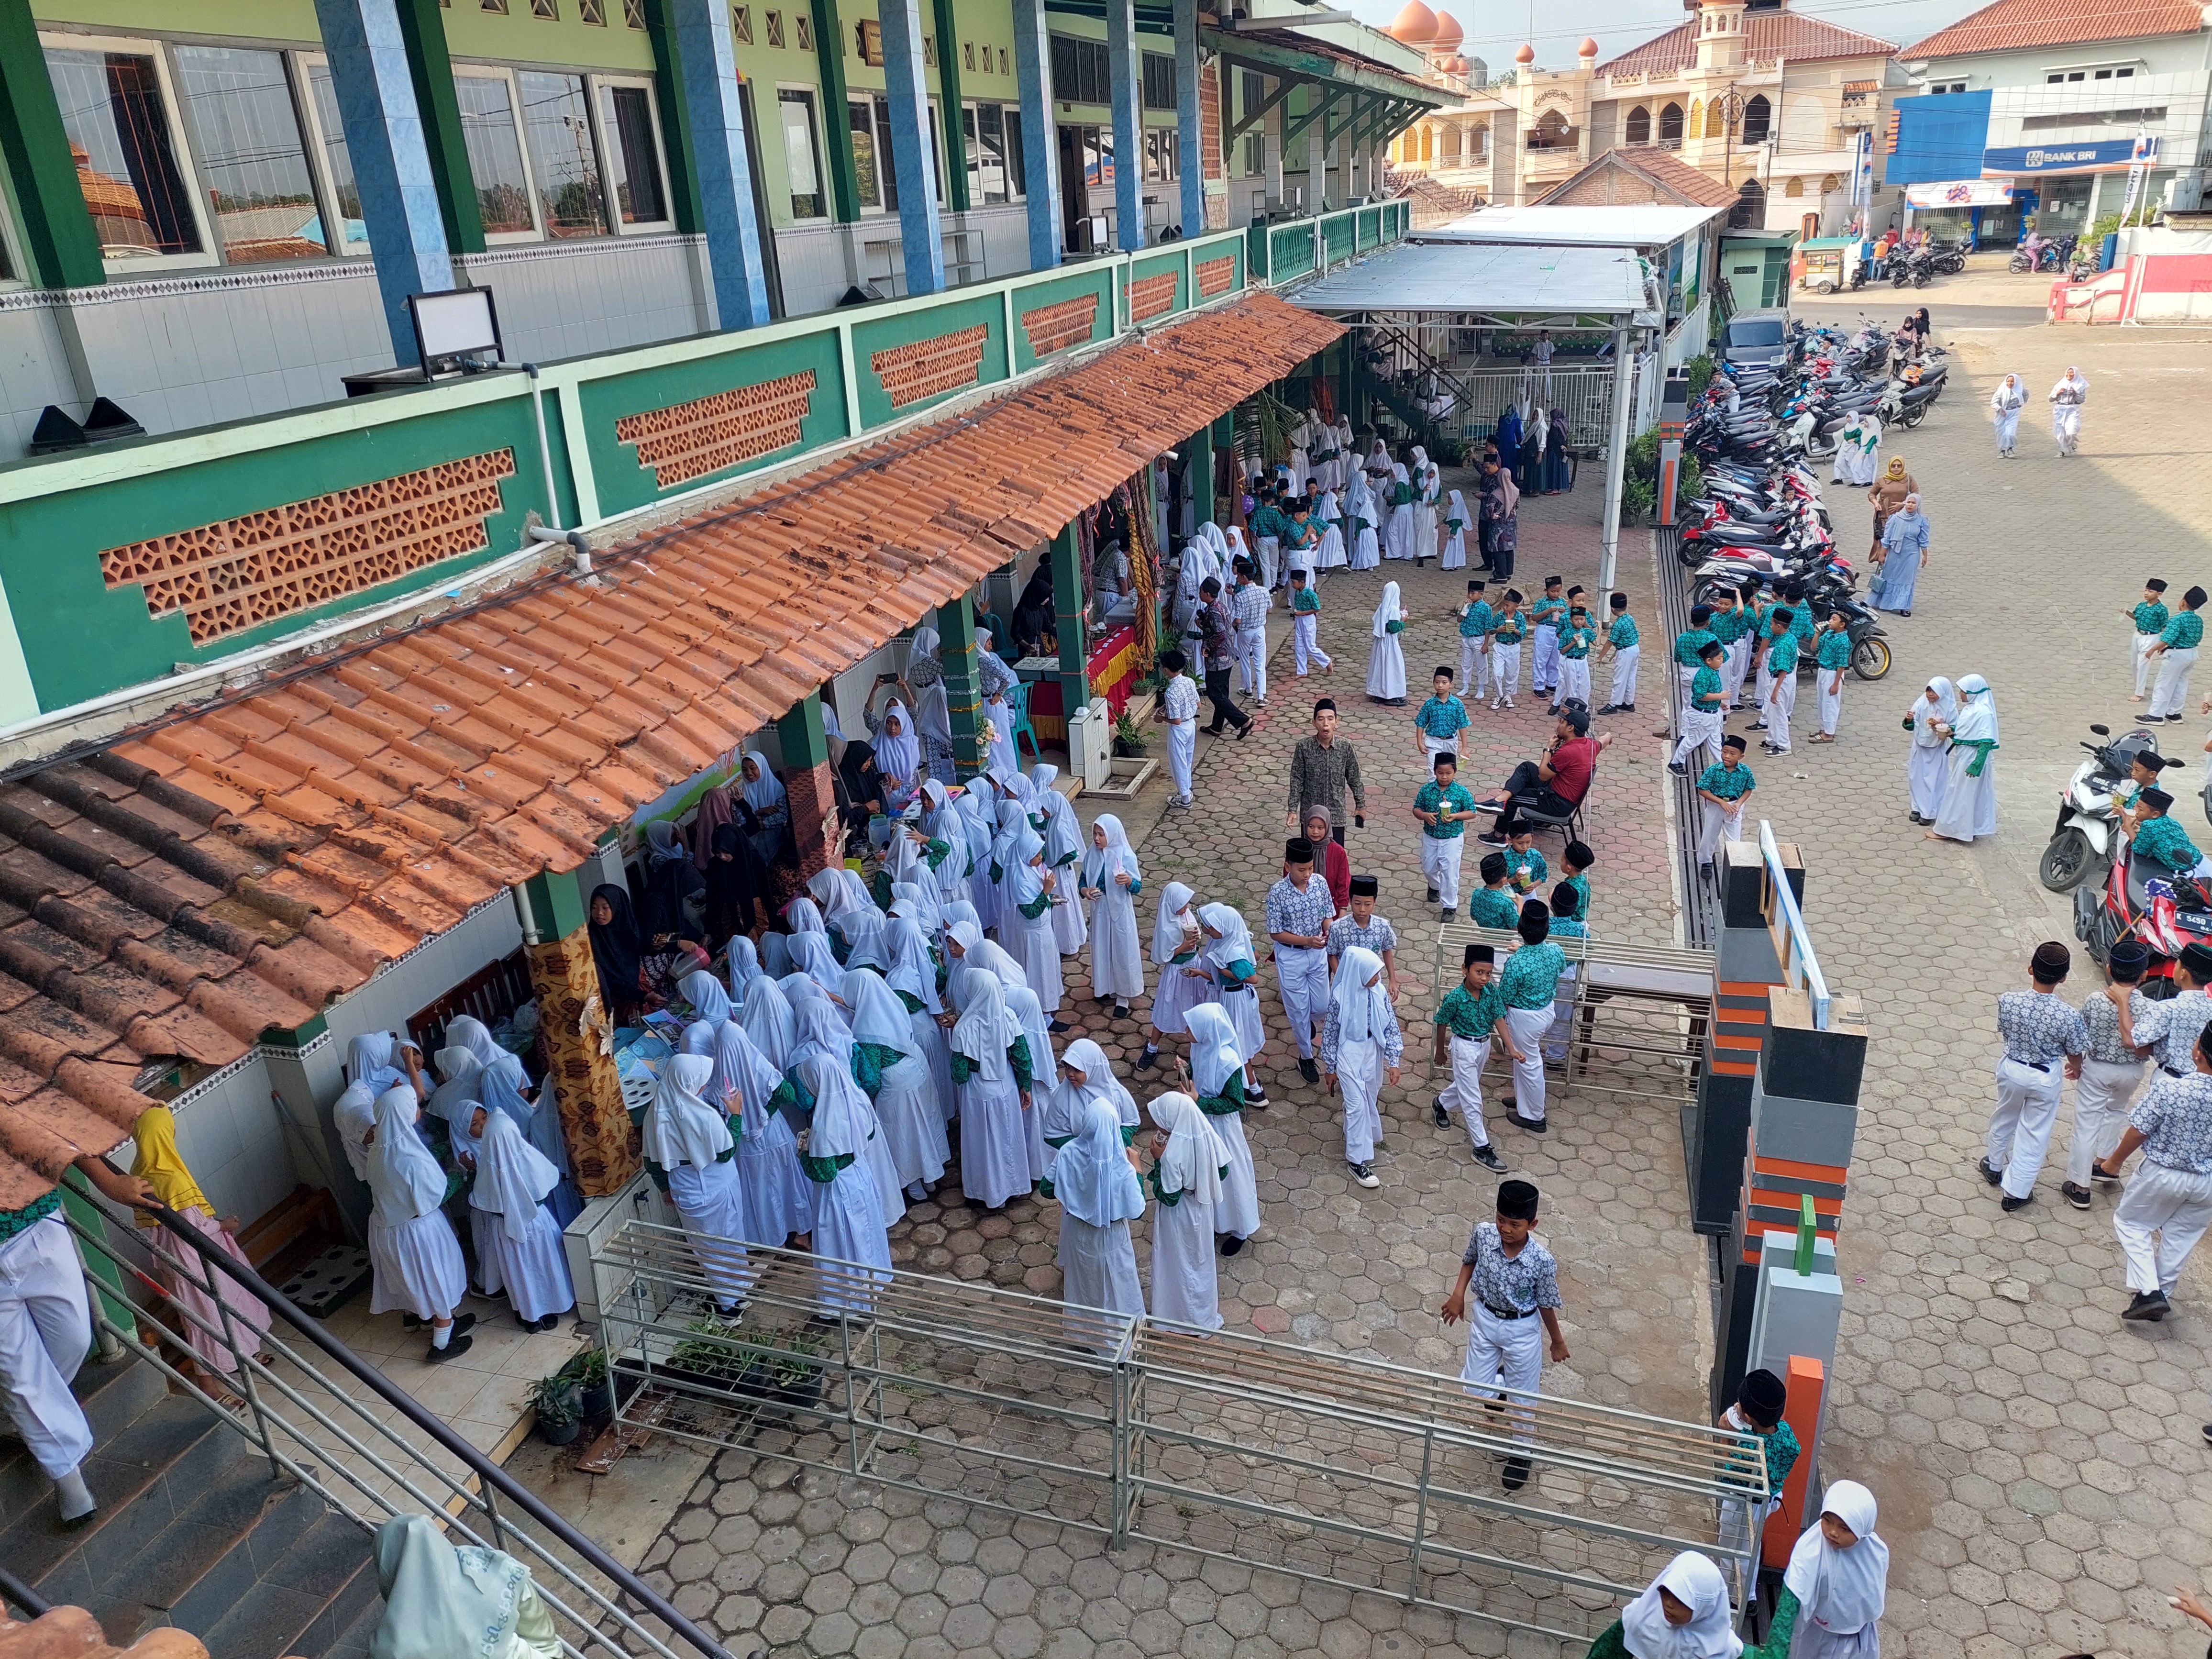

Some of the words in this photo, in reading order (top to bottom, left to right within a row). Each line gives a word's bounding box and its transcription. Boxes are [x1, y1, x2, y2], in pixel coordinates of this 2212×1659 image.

[2044, 152, 2077, 162] BANK
[2077, 150, 2097, 161] BRI
[2186, 915, 2206, 925] 5450
